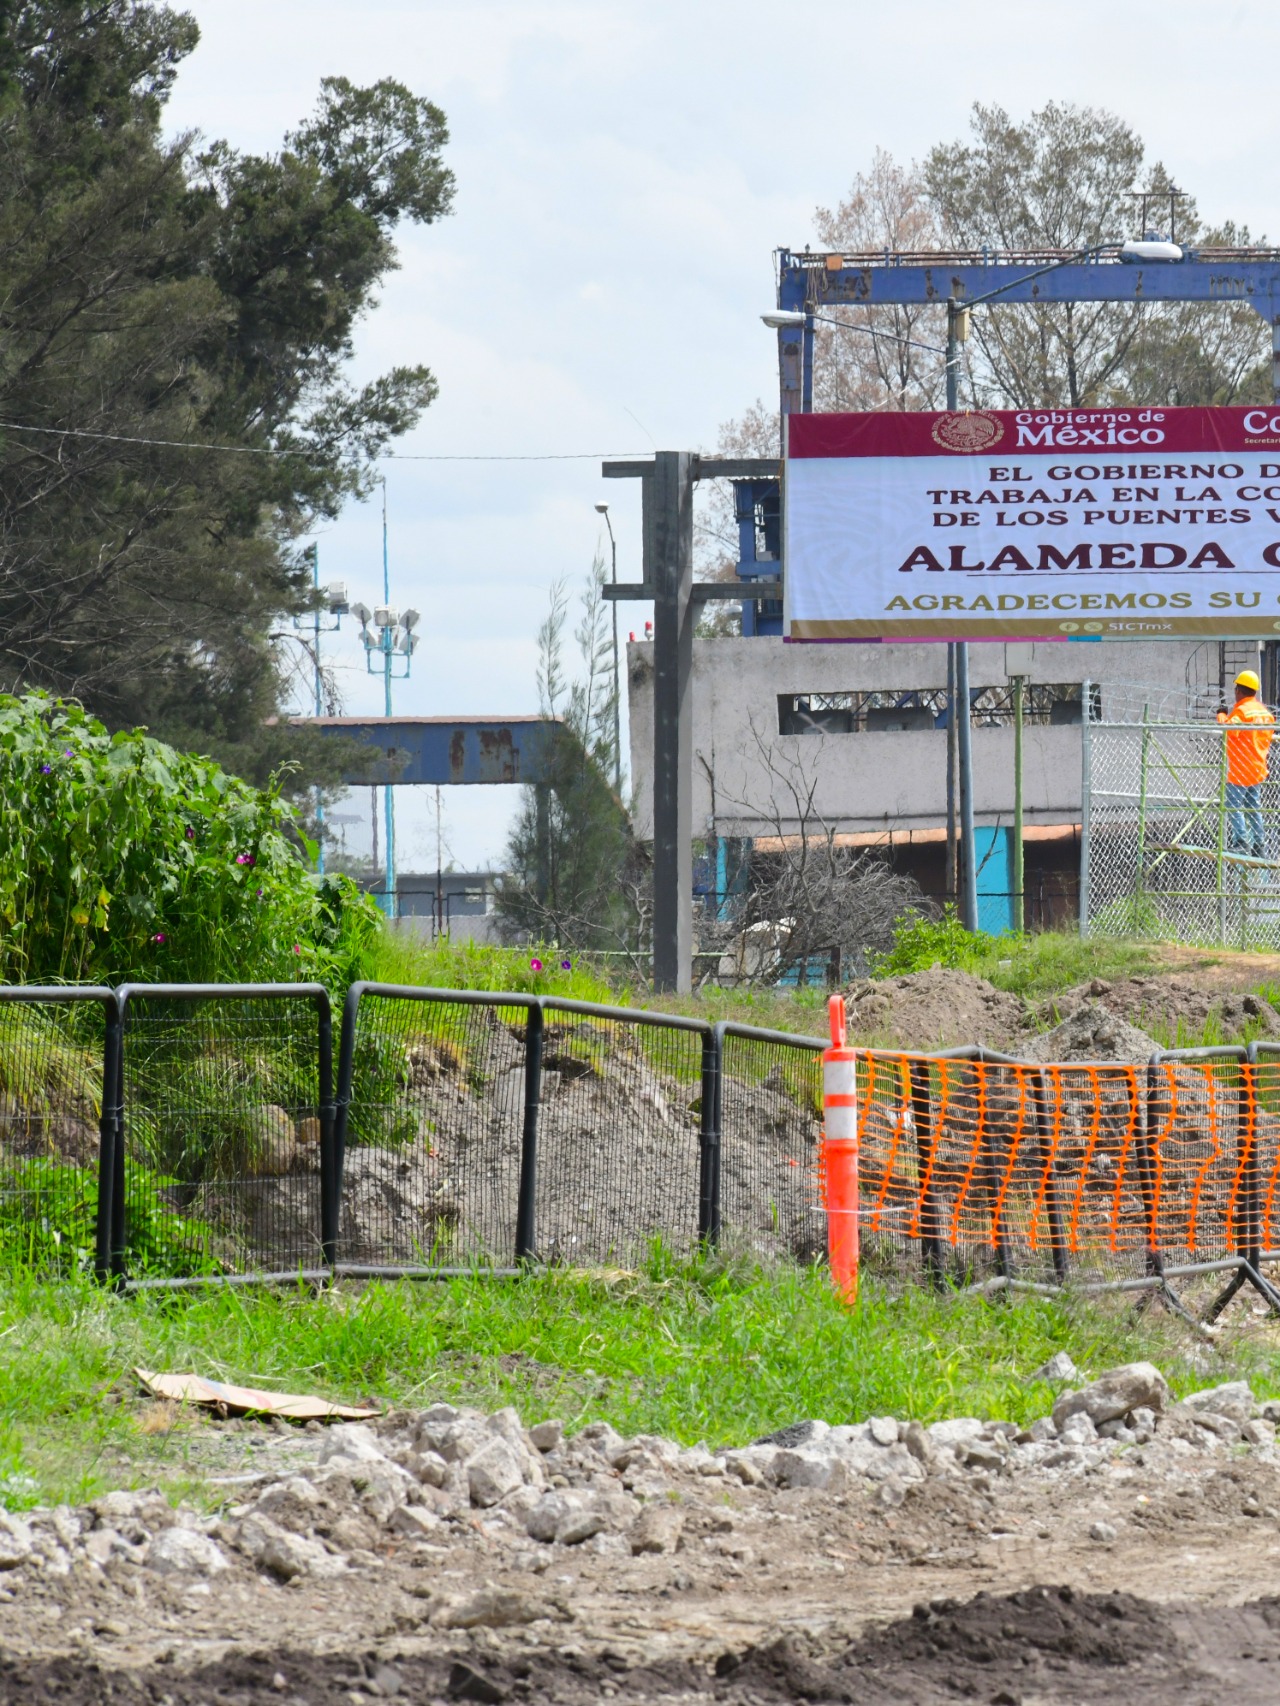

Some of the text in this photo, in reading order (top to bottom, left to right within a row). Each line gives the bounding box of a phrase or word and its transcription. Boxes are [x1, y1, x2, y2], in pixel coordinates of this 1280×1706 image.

[1016, 410, 1132, 424] Gobierno
[1137, 410, 1164, 423] de
[1016, 423, 1164, 446] México
[989, 466, 1032, 481] EL
[1047, 463, 1244, 481] GOBIERNO
[927, 488, 1098, 505] TRABAJA
[1112, 487, 1159, 502] EN
[1175, 485, 1222, 502] LA
[933, 511, 980, 527] DE
[996, 510, 1069, 526] LOS
[1083, 506, 1252, 525] PUENTES
[898, 541, 1236, 571] ALAMEDA
[883, 592, 1193, 611] AGRADECEMOS
[1208, 591, 1261, 608] SU
[1108, 622, 1172, 631] SICTmx
